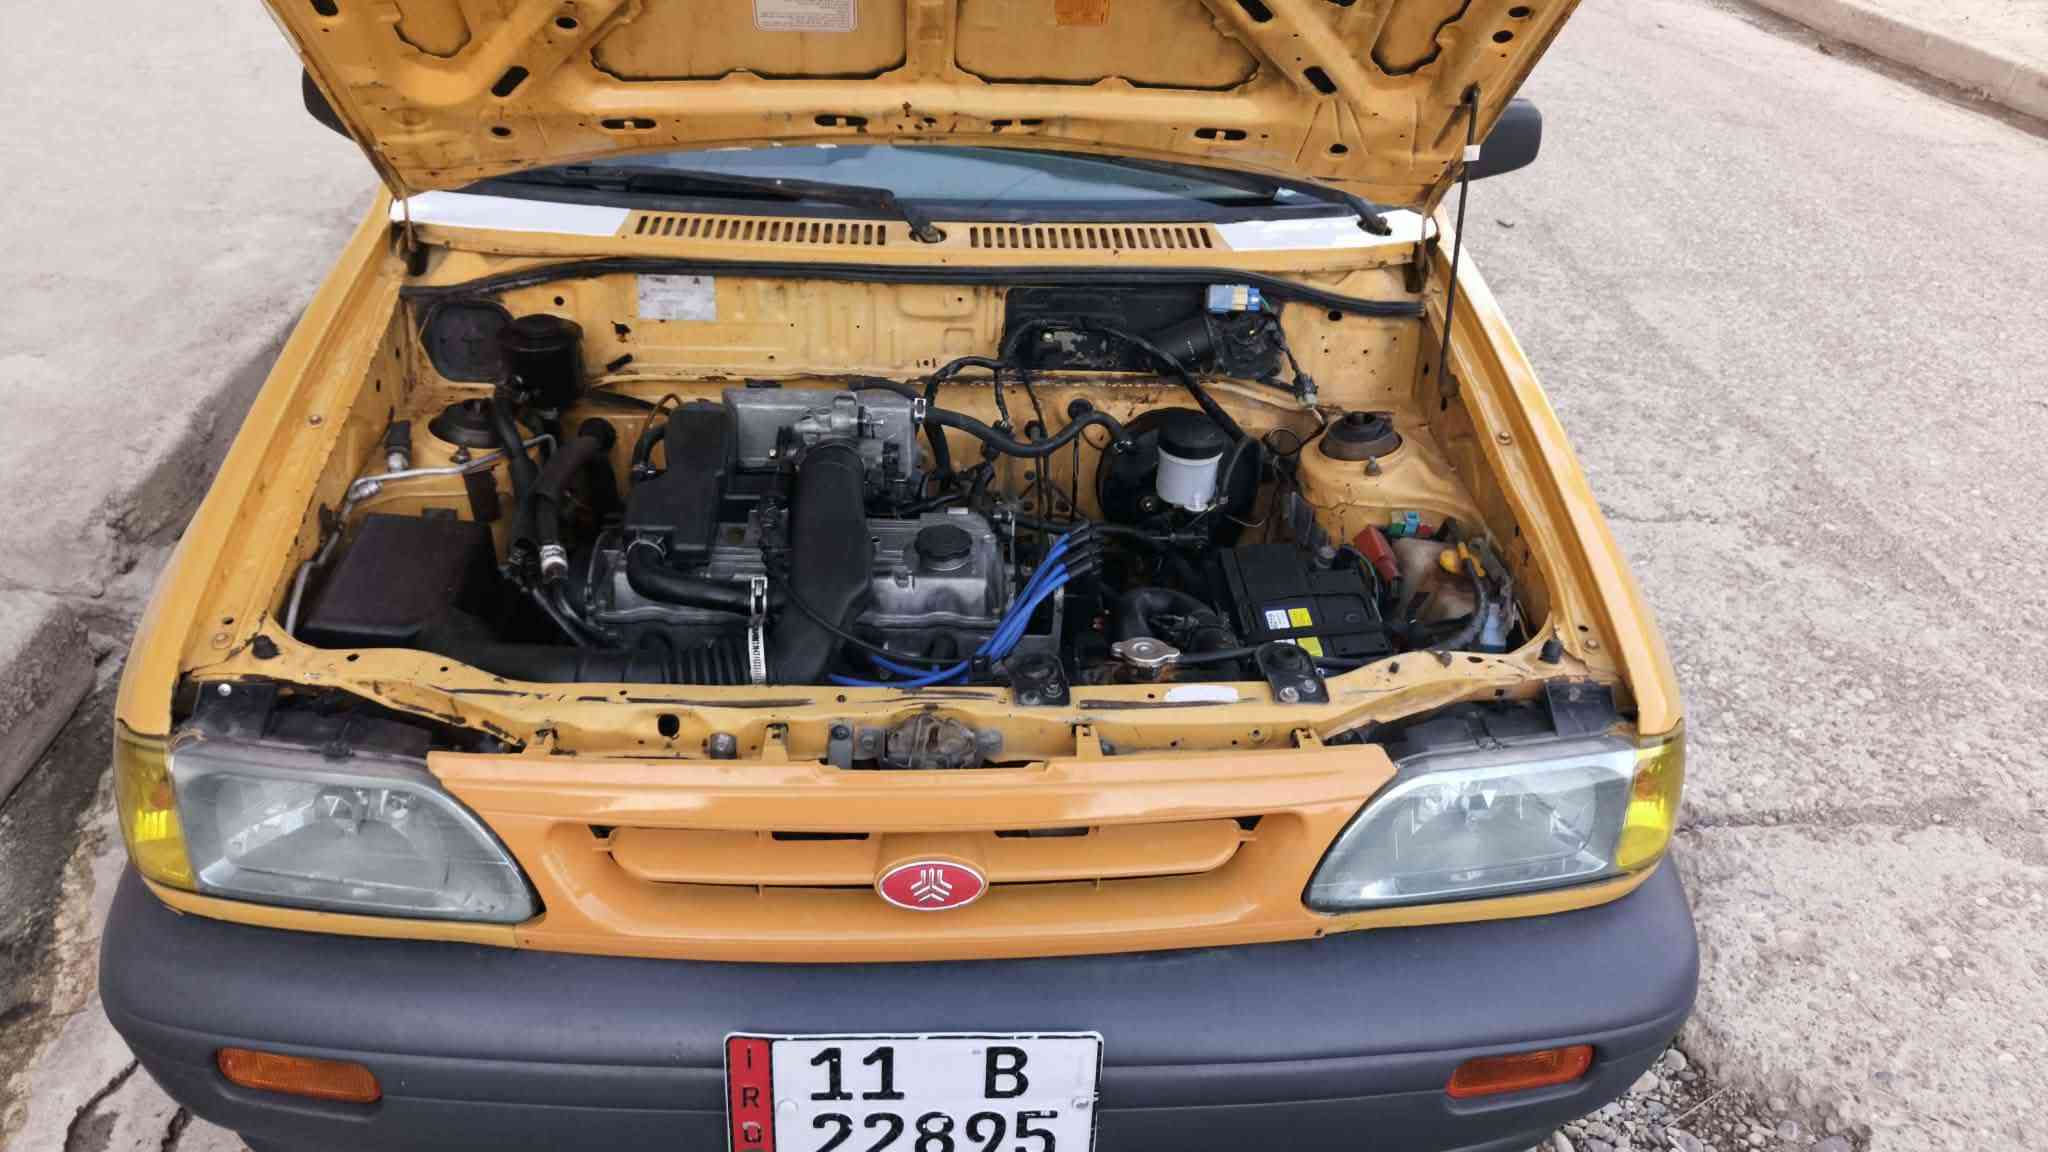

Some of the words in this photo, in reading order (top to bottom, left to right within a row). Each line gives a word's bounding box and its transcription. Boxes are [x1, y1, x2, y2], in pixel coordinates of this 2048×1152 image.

[810, 1046, 905, 1101] 11
[984, 1046, 1029, 1099] B
[812, 1110, 1058, 1152] 22895
